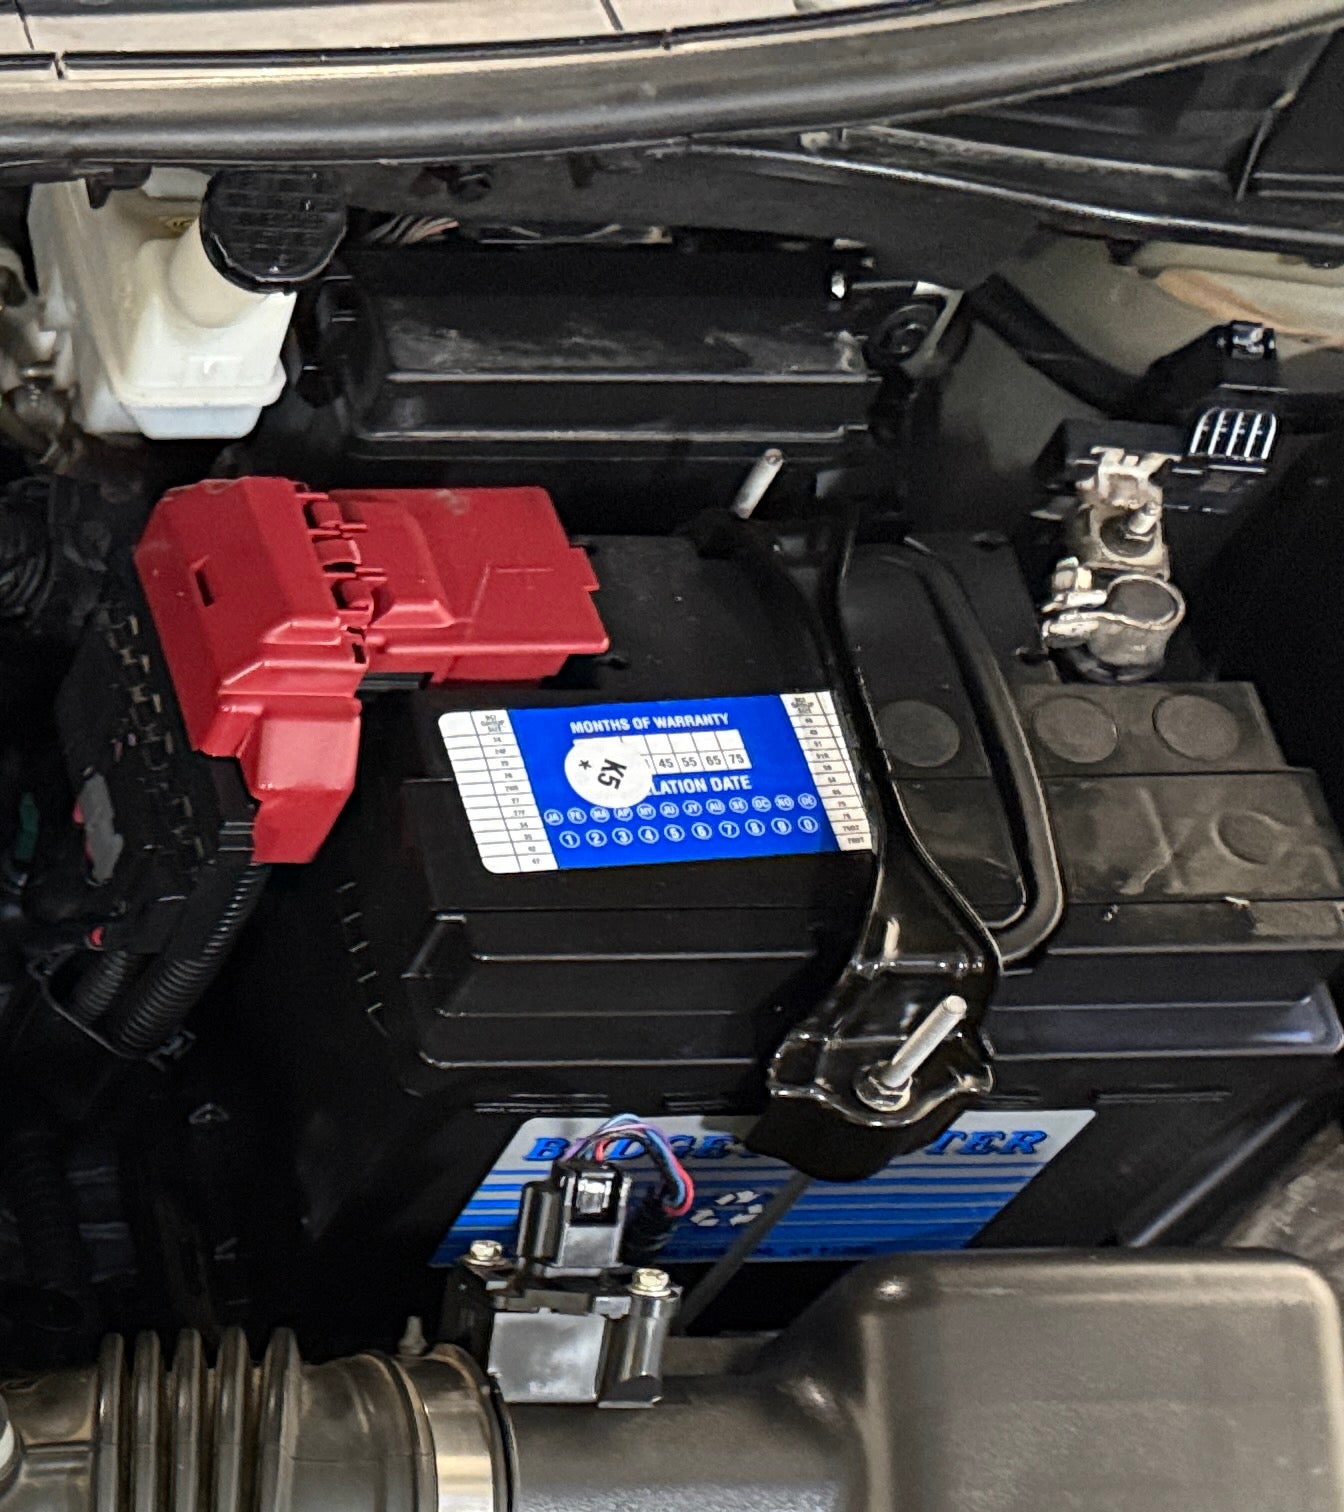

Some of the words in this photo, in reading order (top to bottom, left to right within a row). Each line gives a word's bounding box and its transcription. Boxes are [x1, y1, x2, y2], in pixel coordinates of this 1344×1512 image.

[570, 718, 630, 734] MONTHS
[632, 716, 650, 729] OF
[652, 712, 728, 728] WARRANTY
[659, 758, 674, 769] 45
[681, 756, 697, 768] 55
[729, 753, 744, 765] 75
[597, 758, 627, 790] K5
[648, 778, 707, 795] LATION
[710, 774, 752, 791] DATE
